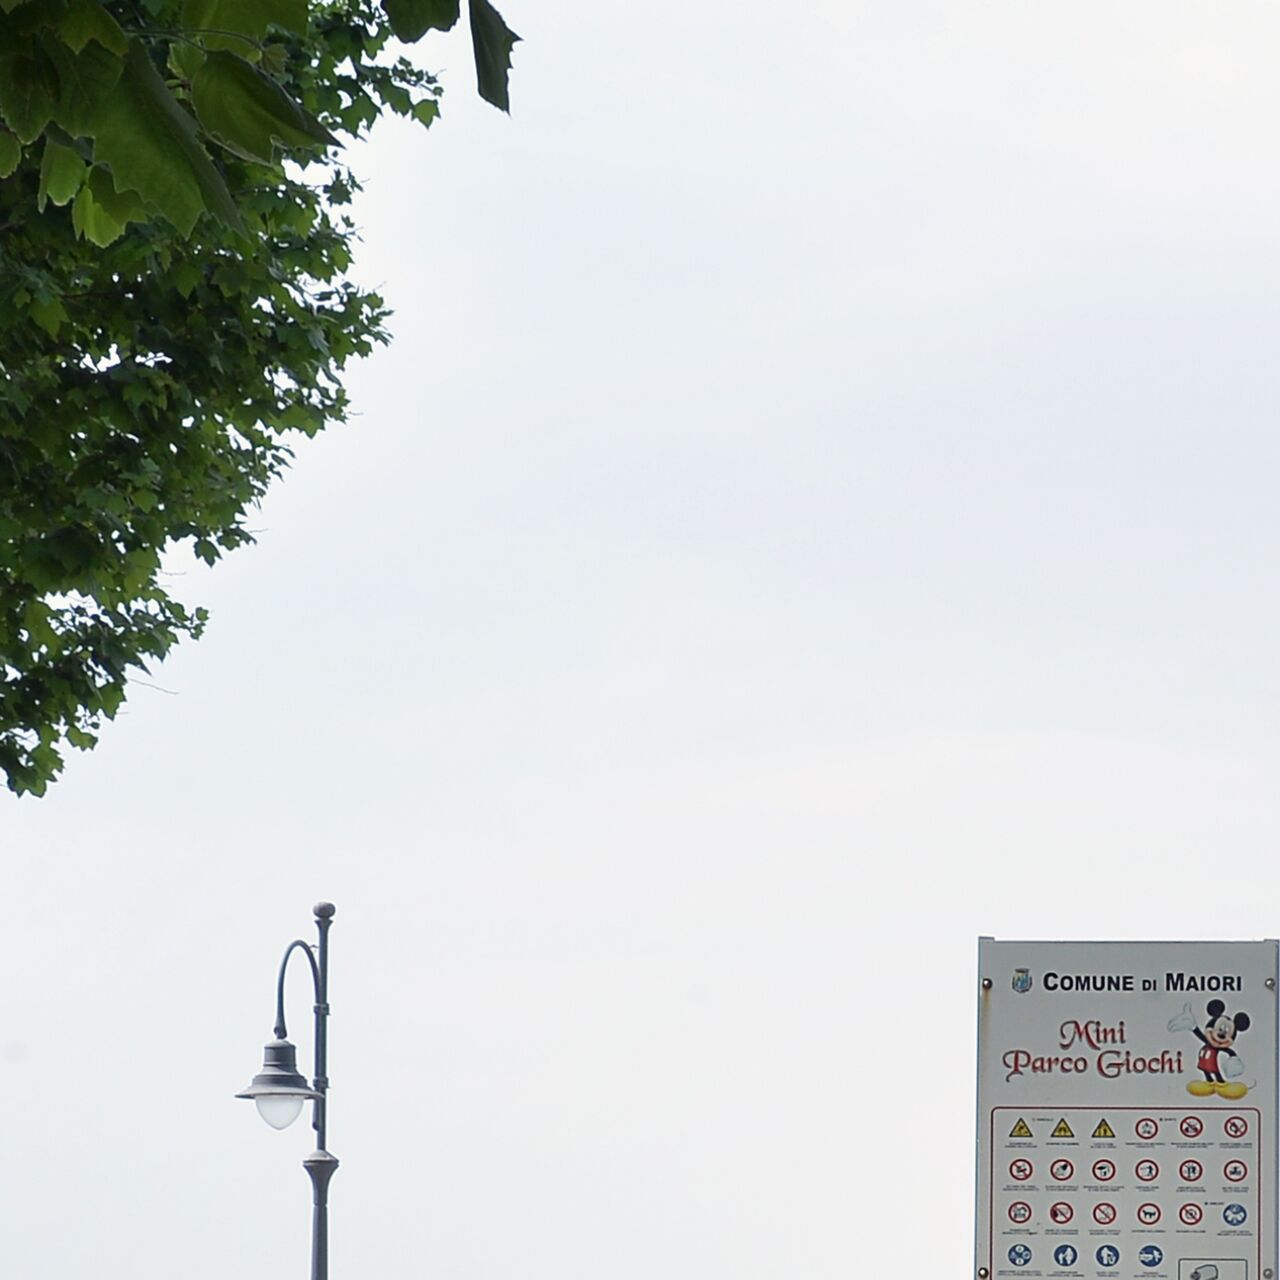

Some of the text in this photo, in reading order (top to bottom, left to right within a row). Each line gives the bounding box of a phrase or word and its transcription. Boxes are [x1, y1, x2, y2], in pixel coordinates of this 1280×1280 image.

[1042, 972, 1135, 992] COMUNE
[1165, 972, 1242, 992] MAIORI
[1059, 1020, 1127, 1051] Mini
[1002, 1050, 1184, 1083] Parco Giochi
